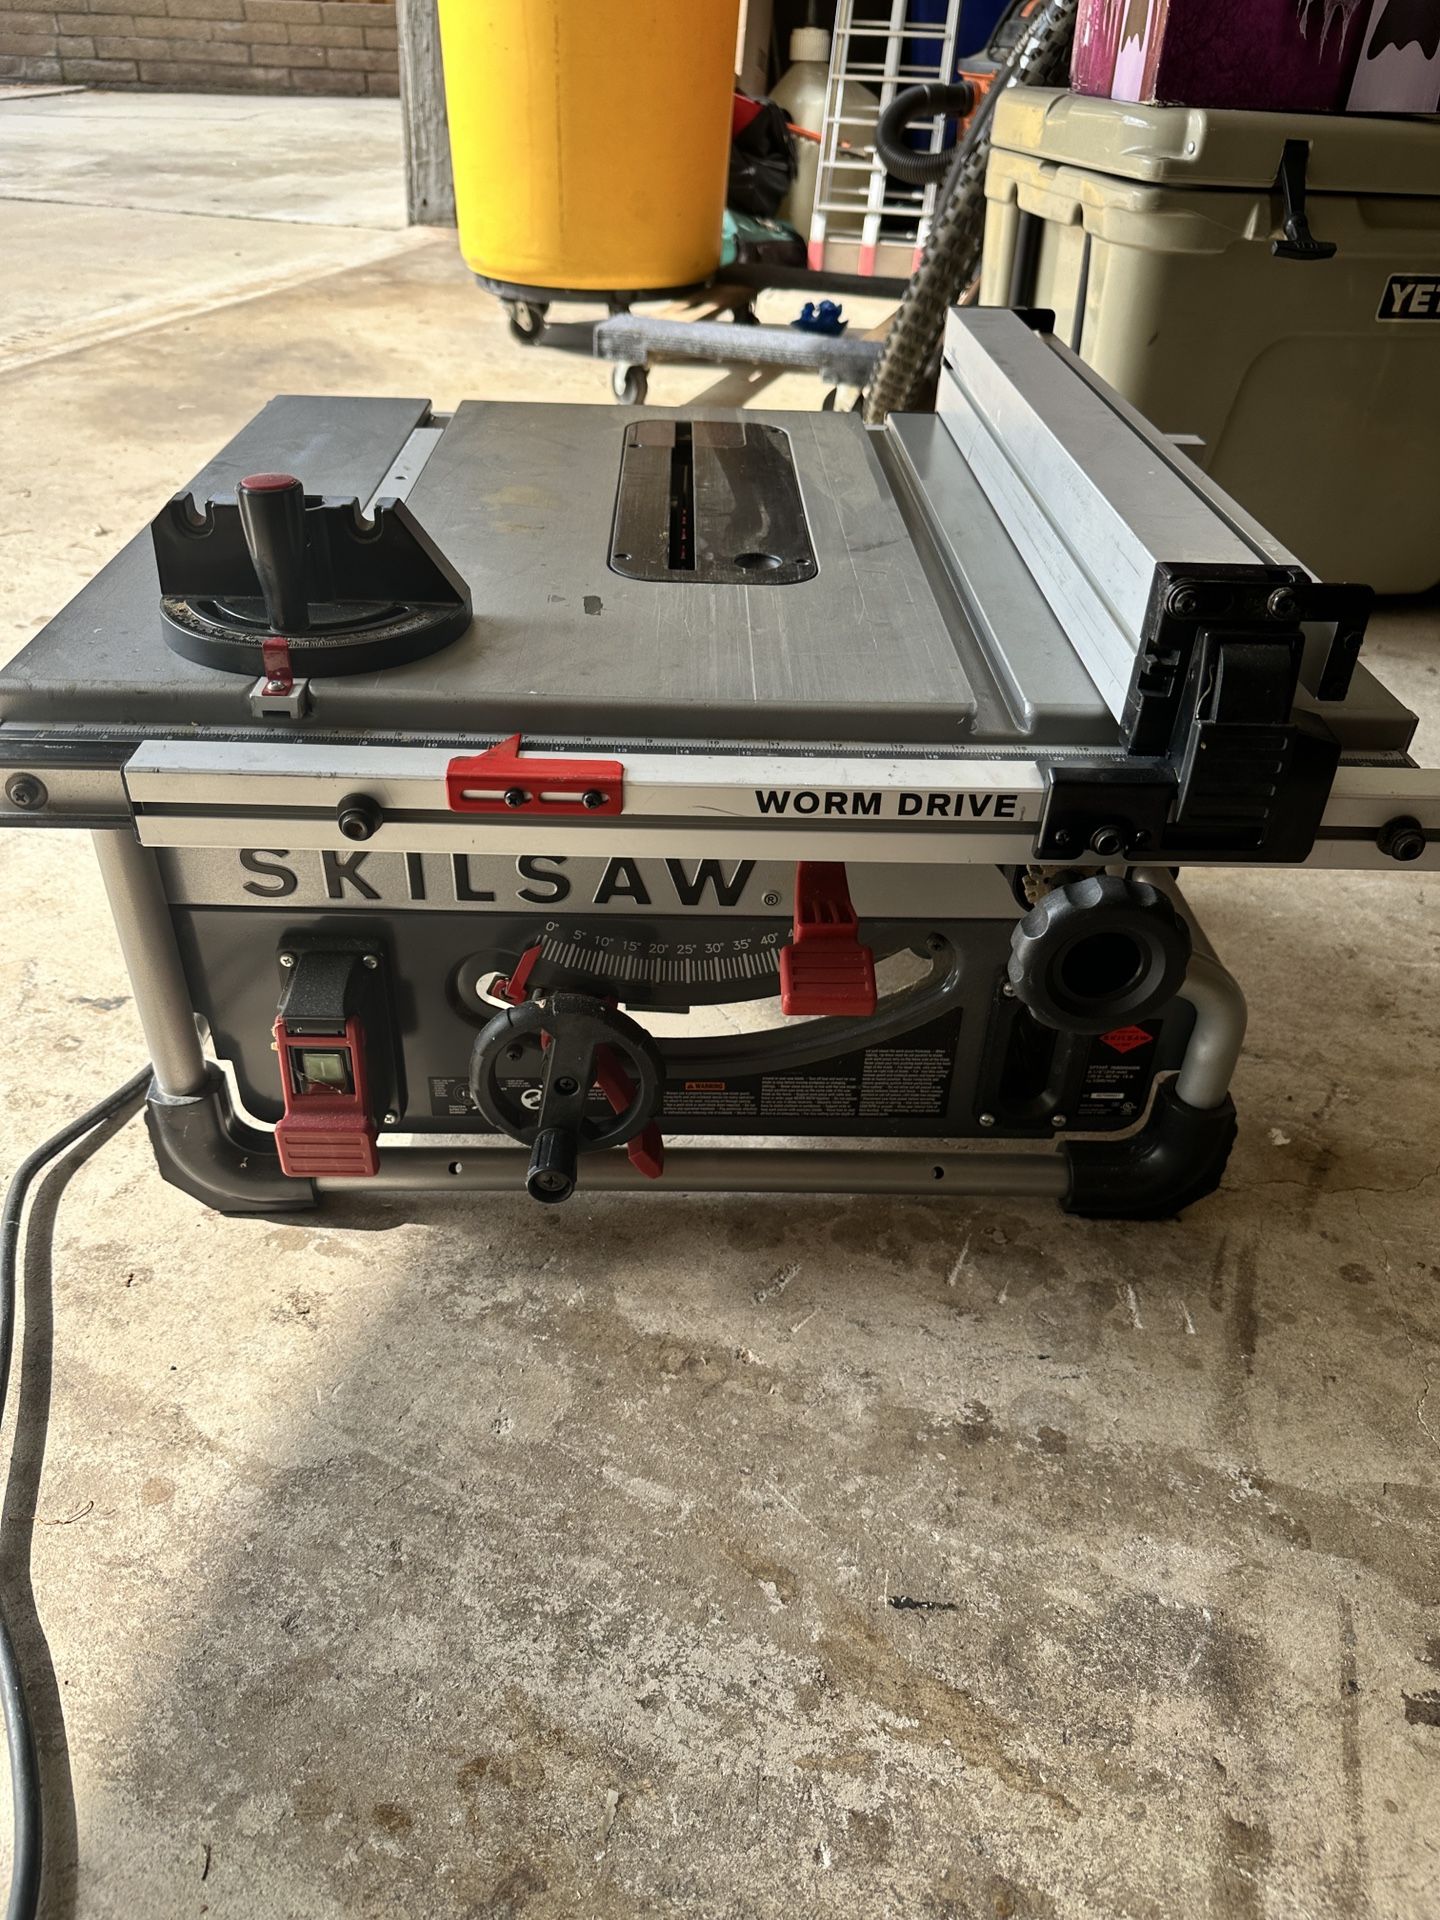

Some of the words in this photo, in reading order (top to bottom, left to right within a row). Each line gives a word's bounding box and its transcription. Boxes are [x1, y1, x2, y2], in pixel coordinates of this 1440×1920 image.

[1391, 284, 1440, 312] YE
[755, 790, 882, 815] WORM
[897, 793, 1018, 818] DRIVE
[594, 935, 614, 947] 10°
[623, 941, 642, 951] 15°
[649, 943, 669, 953] 20°
[677, 944, 697, 954] 25°
[704, 942, 725, 953] 30°
[732, 938, 752, 950] 35°
[760, 932, 779, 945] 40°
